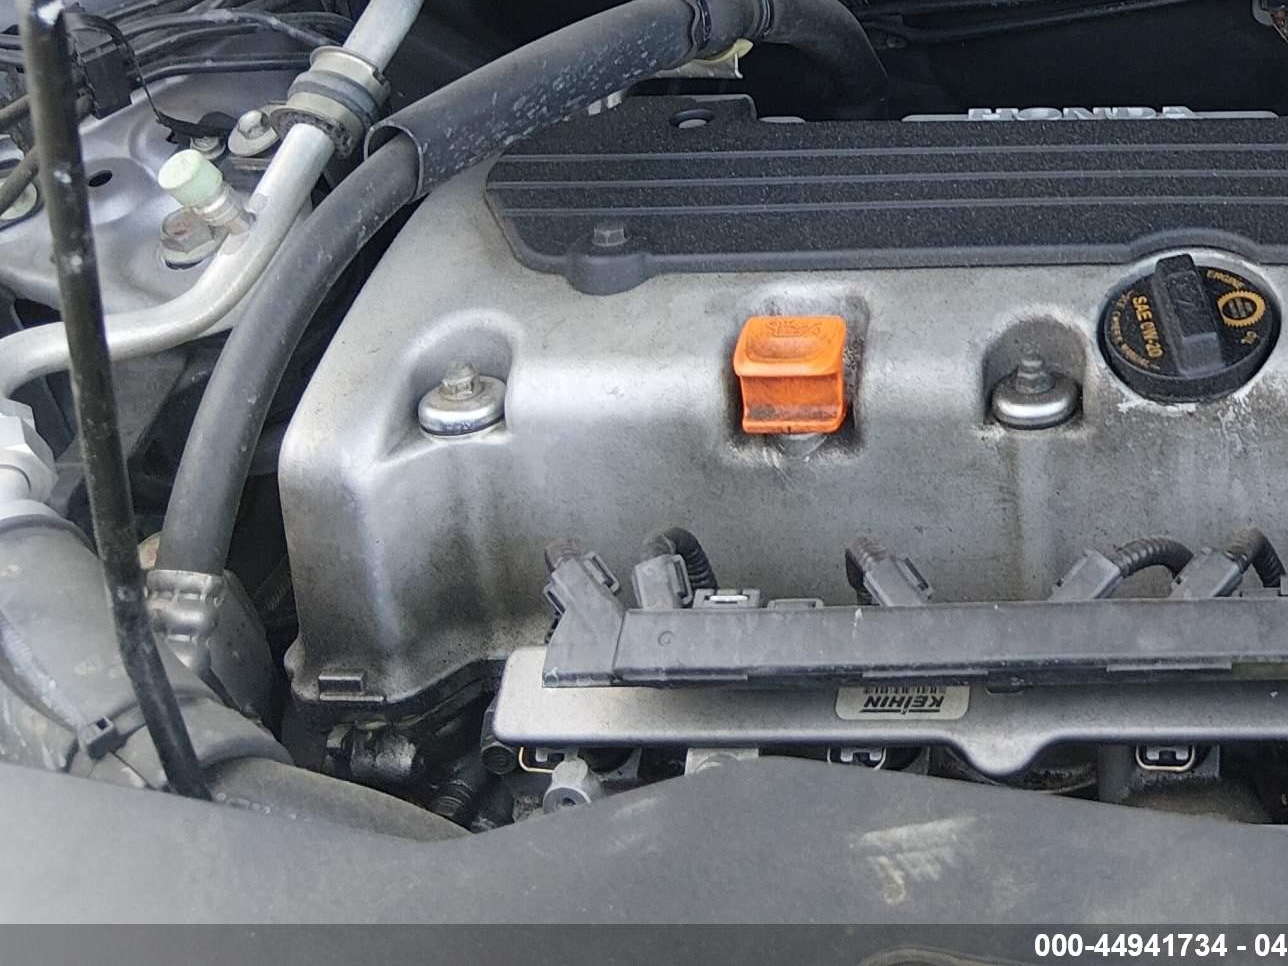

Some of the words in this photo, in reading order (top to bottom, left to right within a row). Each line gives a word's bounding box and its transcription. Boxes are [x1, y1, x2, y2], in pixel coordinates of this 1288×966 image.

[1132, 295, 1154, 322] SAE
[1140, 322, 1164, 359] 0W-20
[863, 694, 944, 714] KEIHIN
